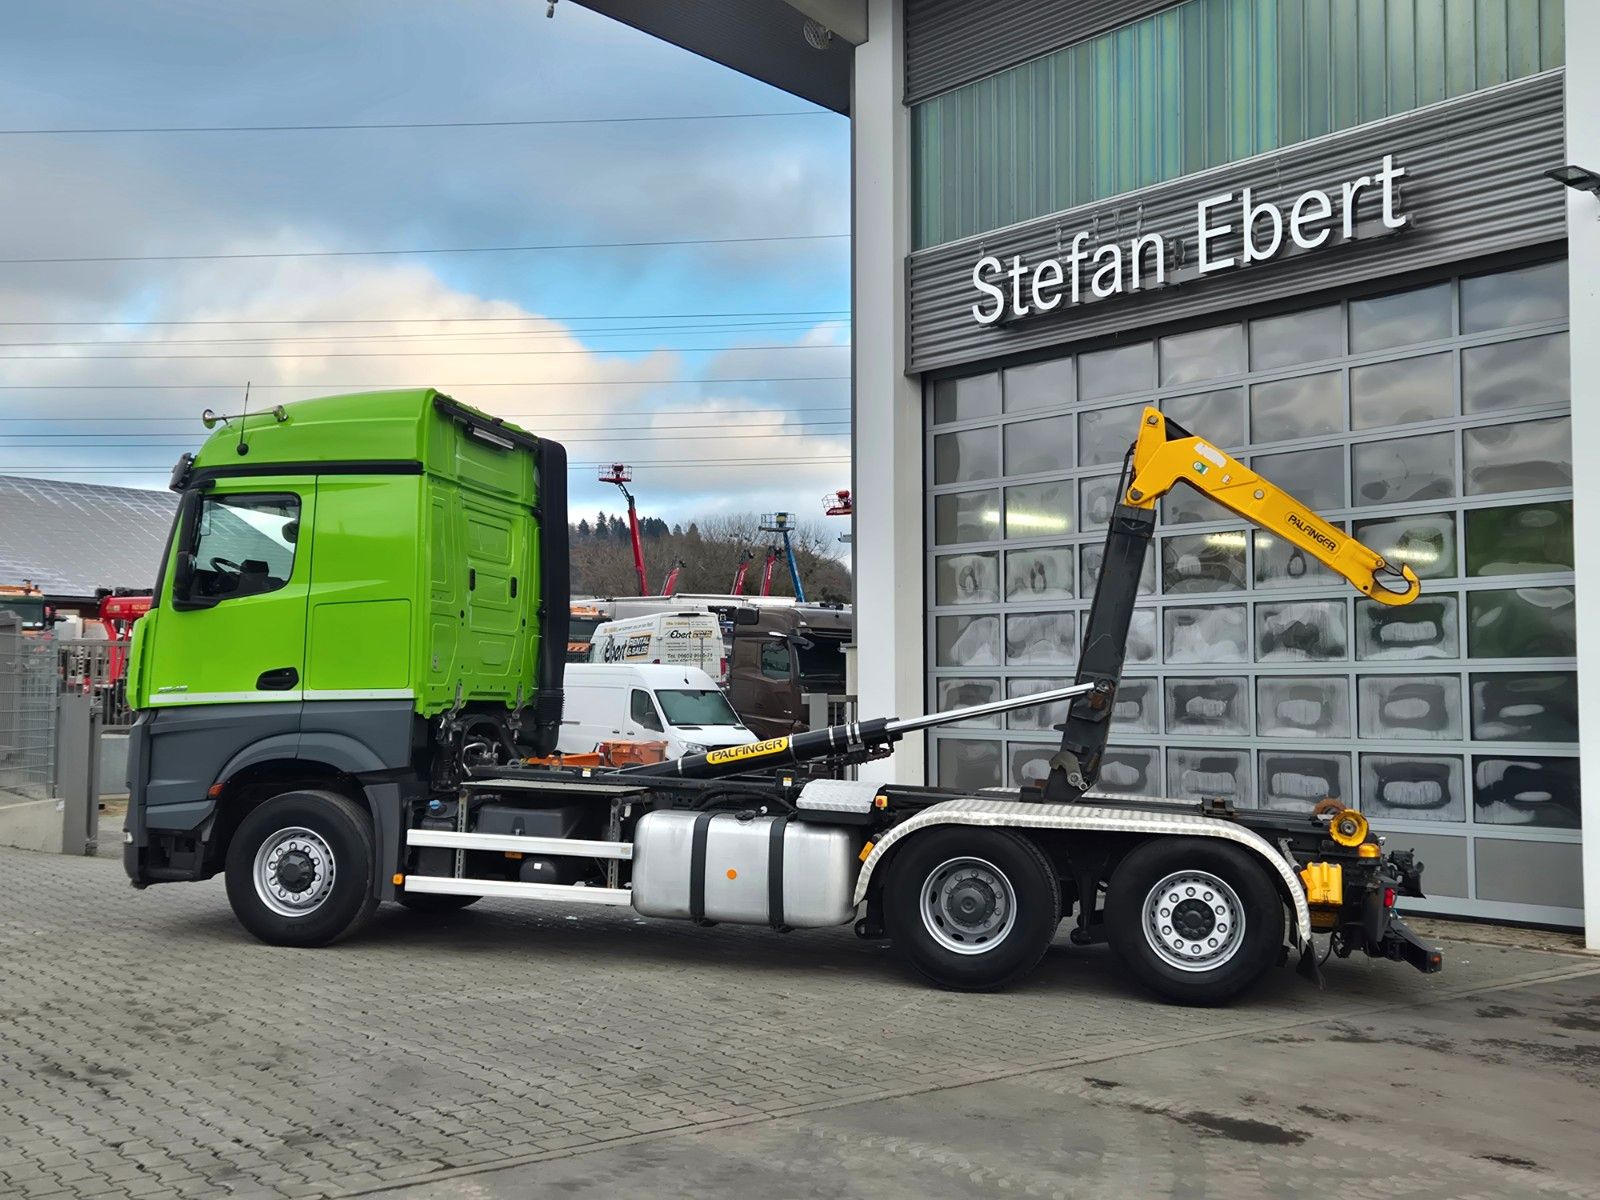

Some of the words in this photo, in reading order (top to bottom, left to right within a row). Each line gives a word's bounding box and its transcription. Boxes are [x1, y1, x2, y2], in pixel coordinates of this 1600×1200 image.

[971, 231, 1166, 325] Stefan
[1197, 154, 1407, 274] Ebert
[1287, 514, 1337, 551] PALFINGER
[711, 739, 783, 761] PALFINGER
